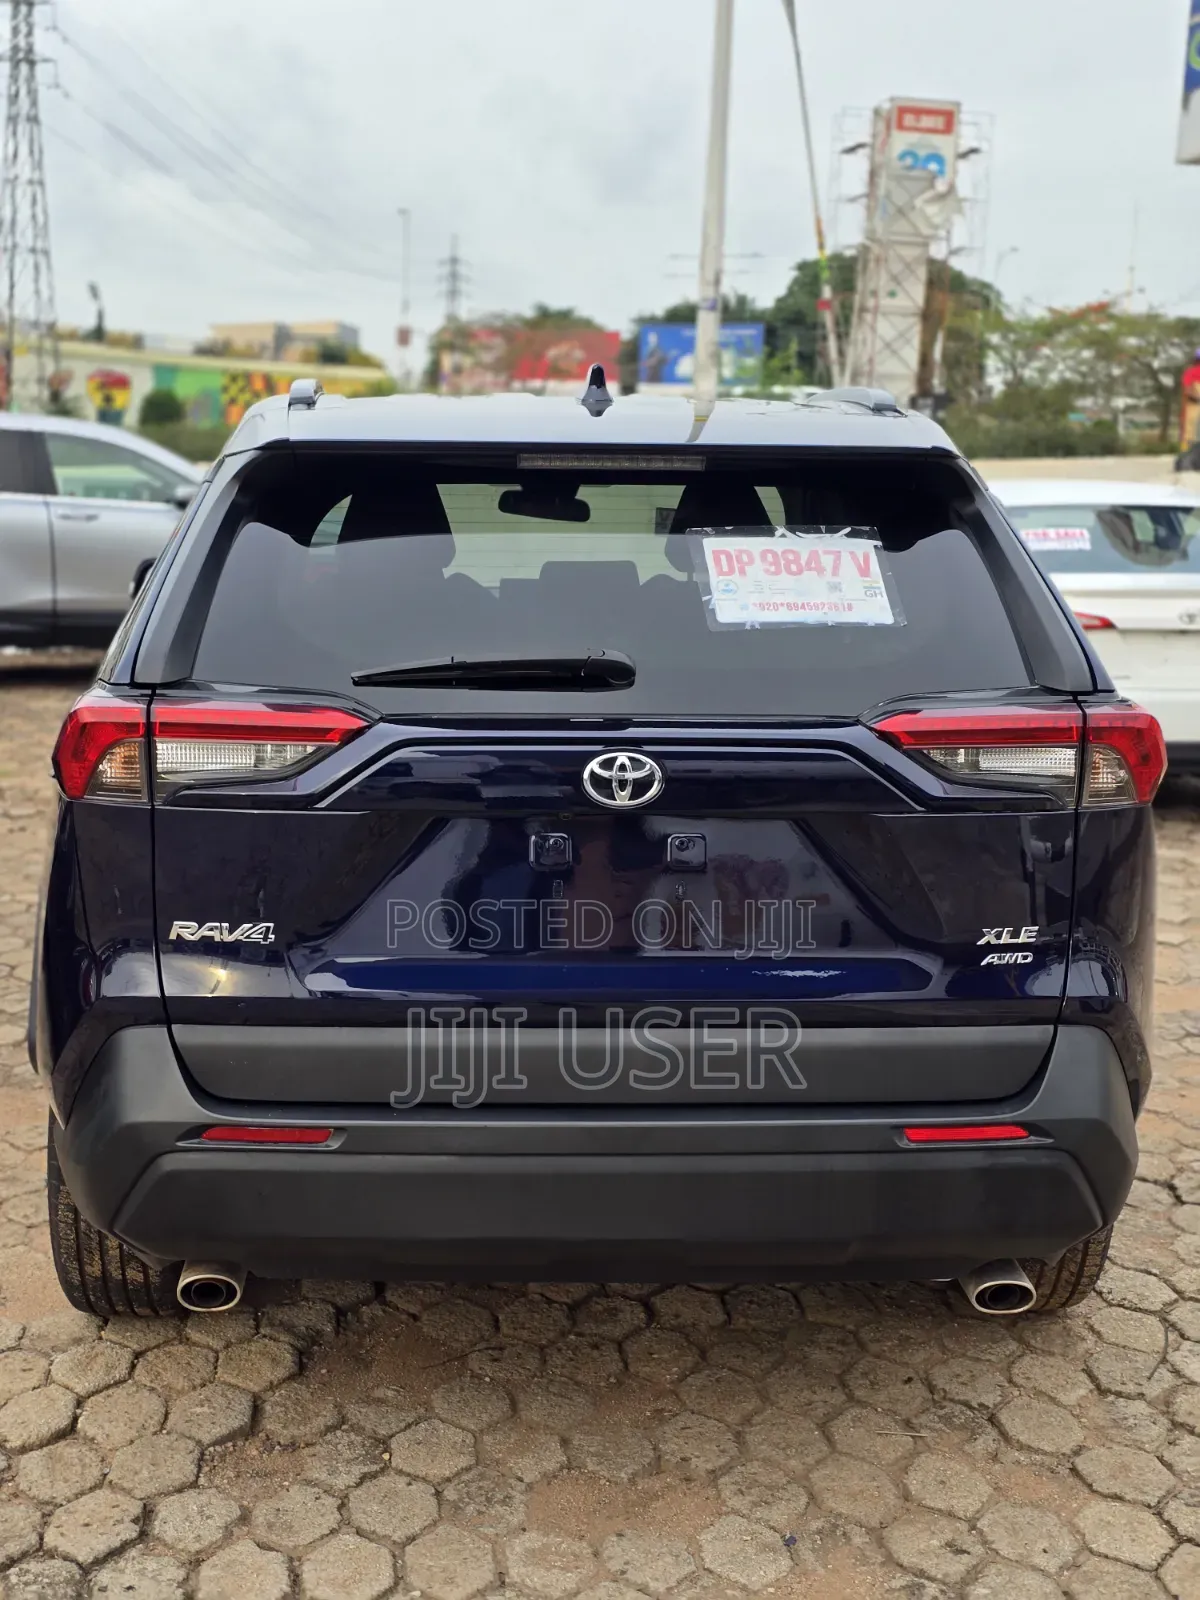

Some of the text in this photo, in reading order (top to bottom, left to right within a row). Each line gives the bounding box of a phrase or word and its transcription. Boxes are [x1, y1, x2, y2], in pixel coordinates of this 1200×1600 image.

[712, 549, 873, 578] DP 9847 V
[864, 588, 884, 598] GH
[168, 921, 275, 944] RAV4
[976, 926, 1039, 945] XLE
[980, 952, 1033, 966] AWD
